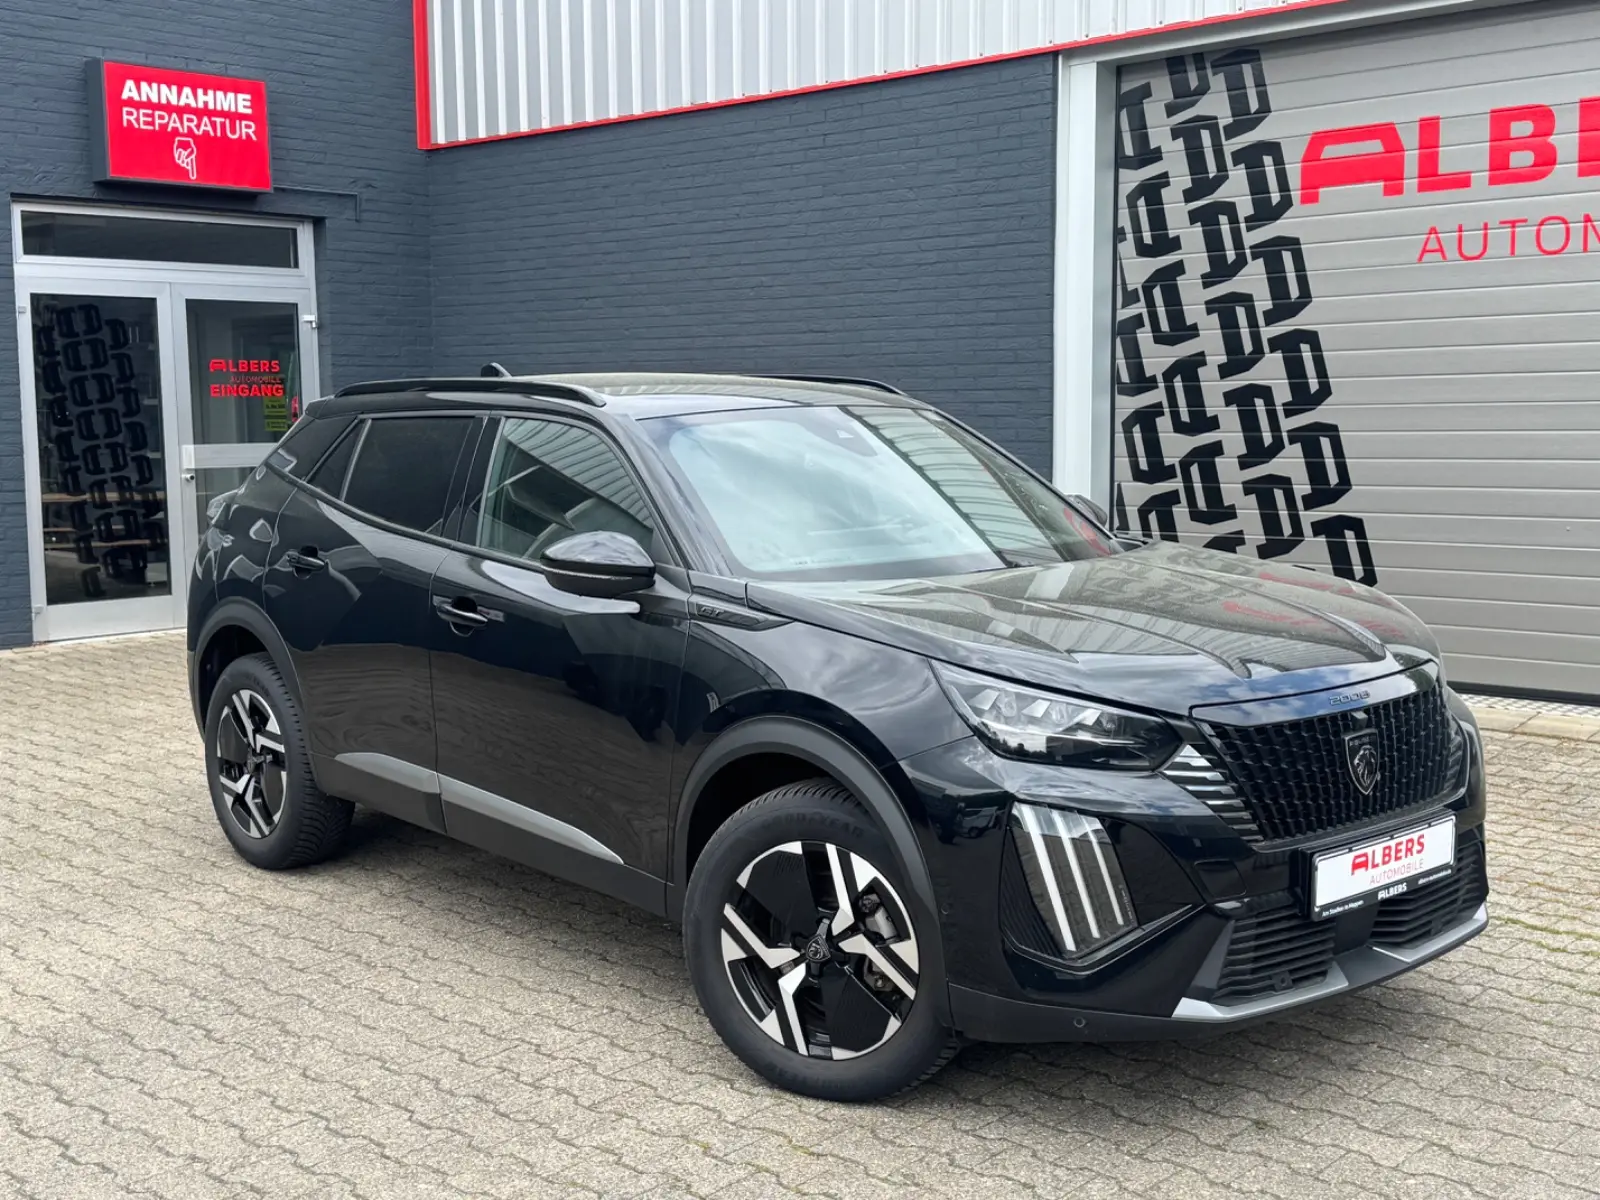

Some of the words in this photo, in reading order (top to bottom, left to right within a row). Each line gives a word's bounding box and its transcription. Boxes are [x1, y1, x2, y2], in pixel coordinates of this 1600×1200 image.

[121, 79, 252, 114] ANNAHME
[122, 107, 257, 141] REPARATUR
[208, 358, 281, 372] ALBERS
[230, 375, 282, 383] AUTOMOBILE
[209, 384, 284, 398] EINGANG
[1351, 833, 1426, 876] ALBERS
[1369, 858, 1425, 886] AUTOMOBILE
[1377, 882, 1408, 900] ALBERS
